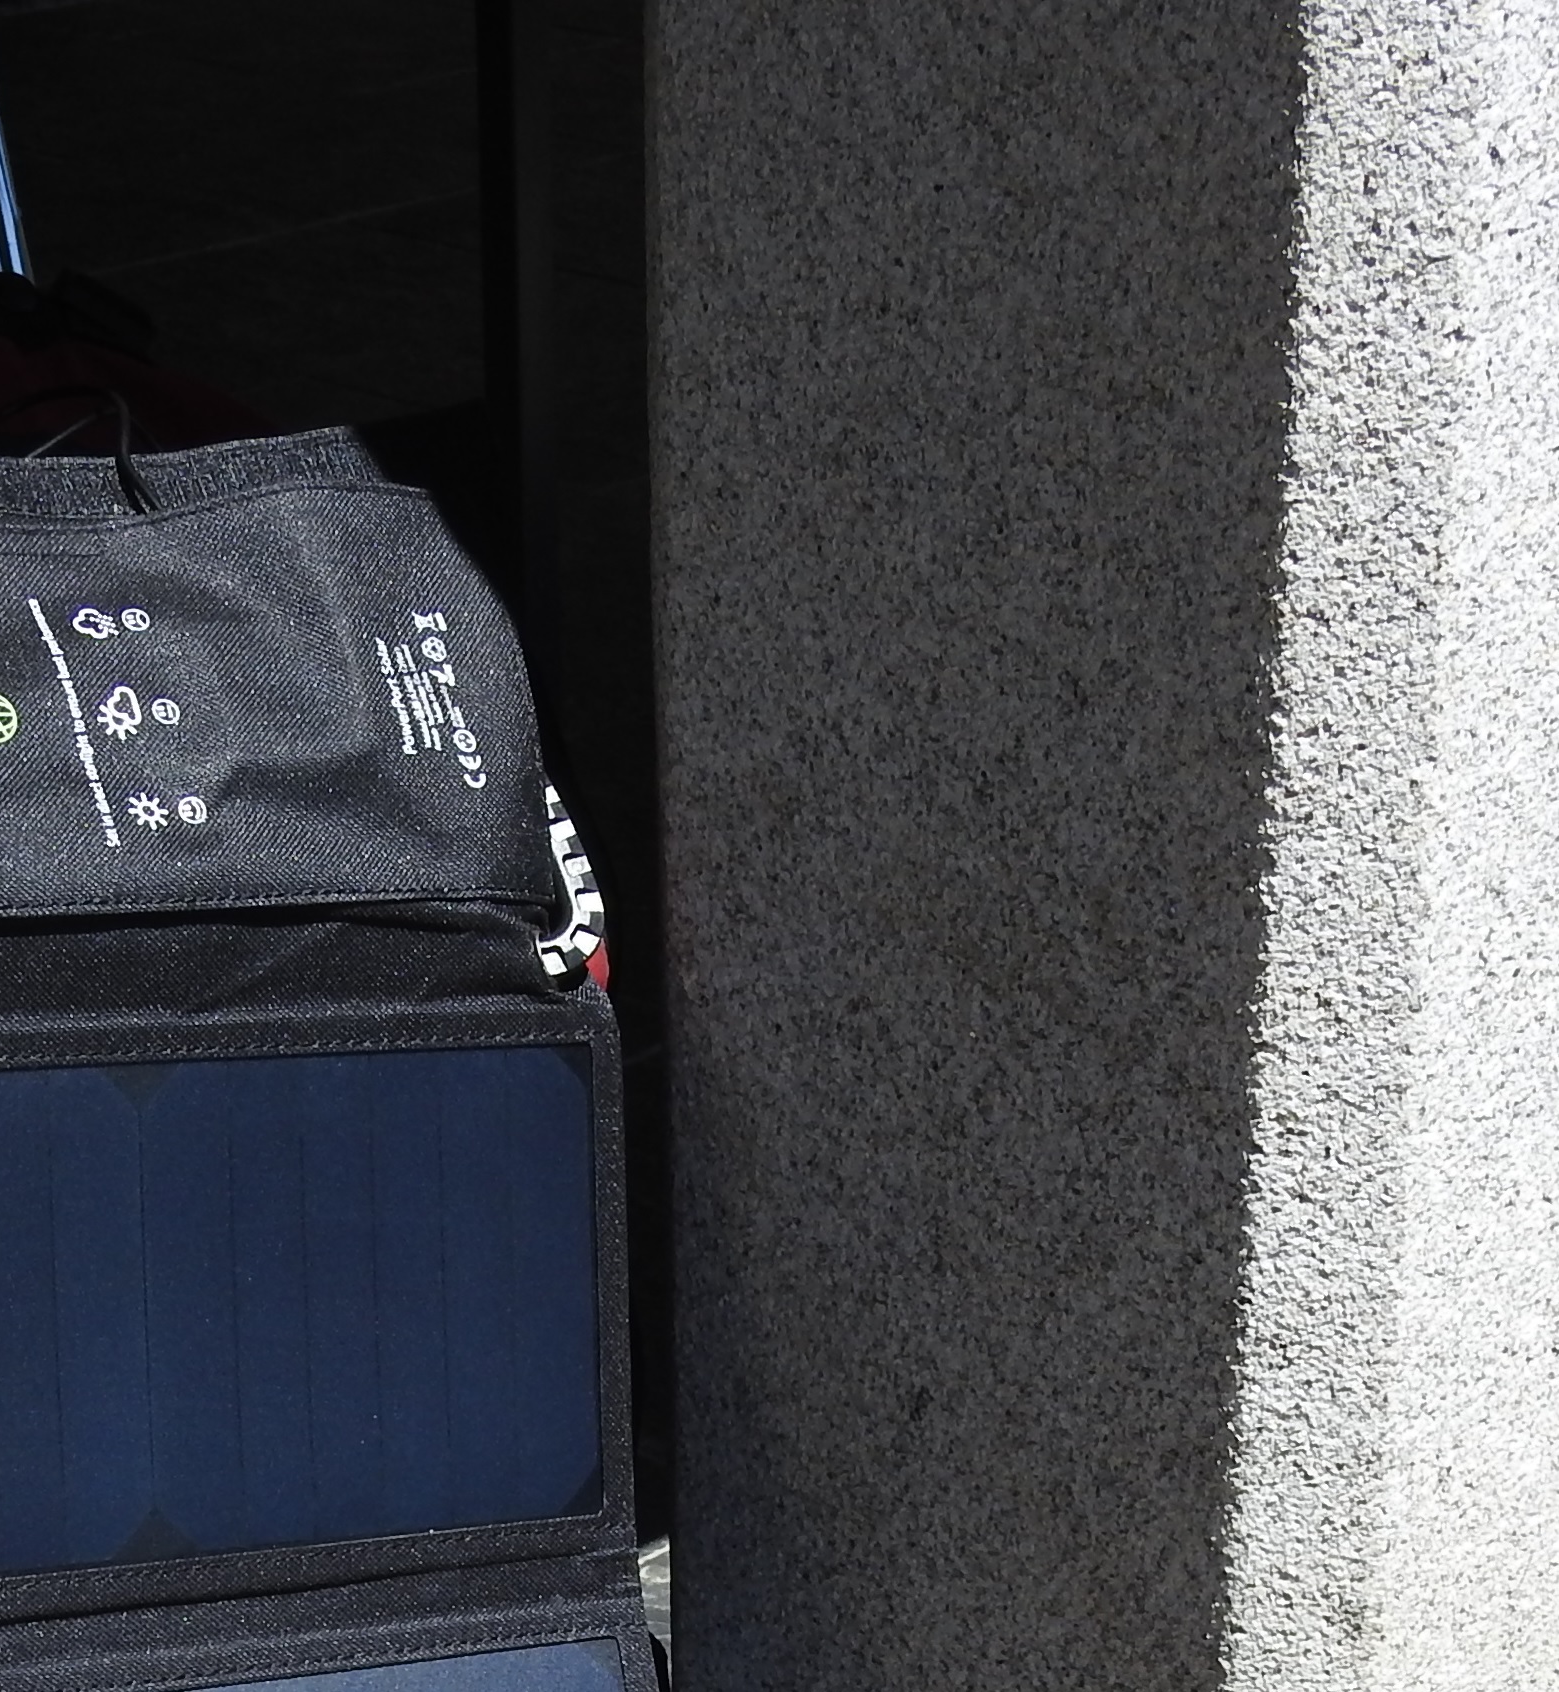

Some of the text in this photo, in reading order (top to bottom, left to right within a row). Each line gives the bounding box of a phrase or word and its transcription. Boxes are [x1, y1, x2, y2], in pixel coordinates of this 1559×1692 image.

[376, 637, 394, 676] Solar
[73, 720, 86, 733] to
[387, 678, 418, 755] PowerPort
[88, 782, 111, 813] direct
[102, 815, 115, 827] in
